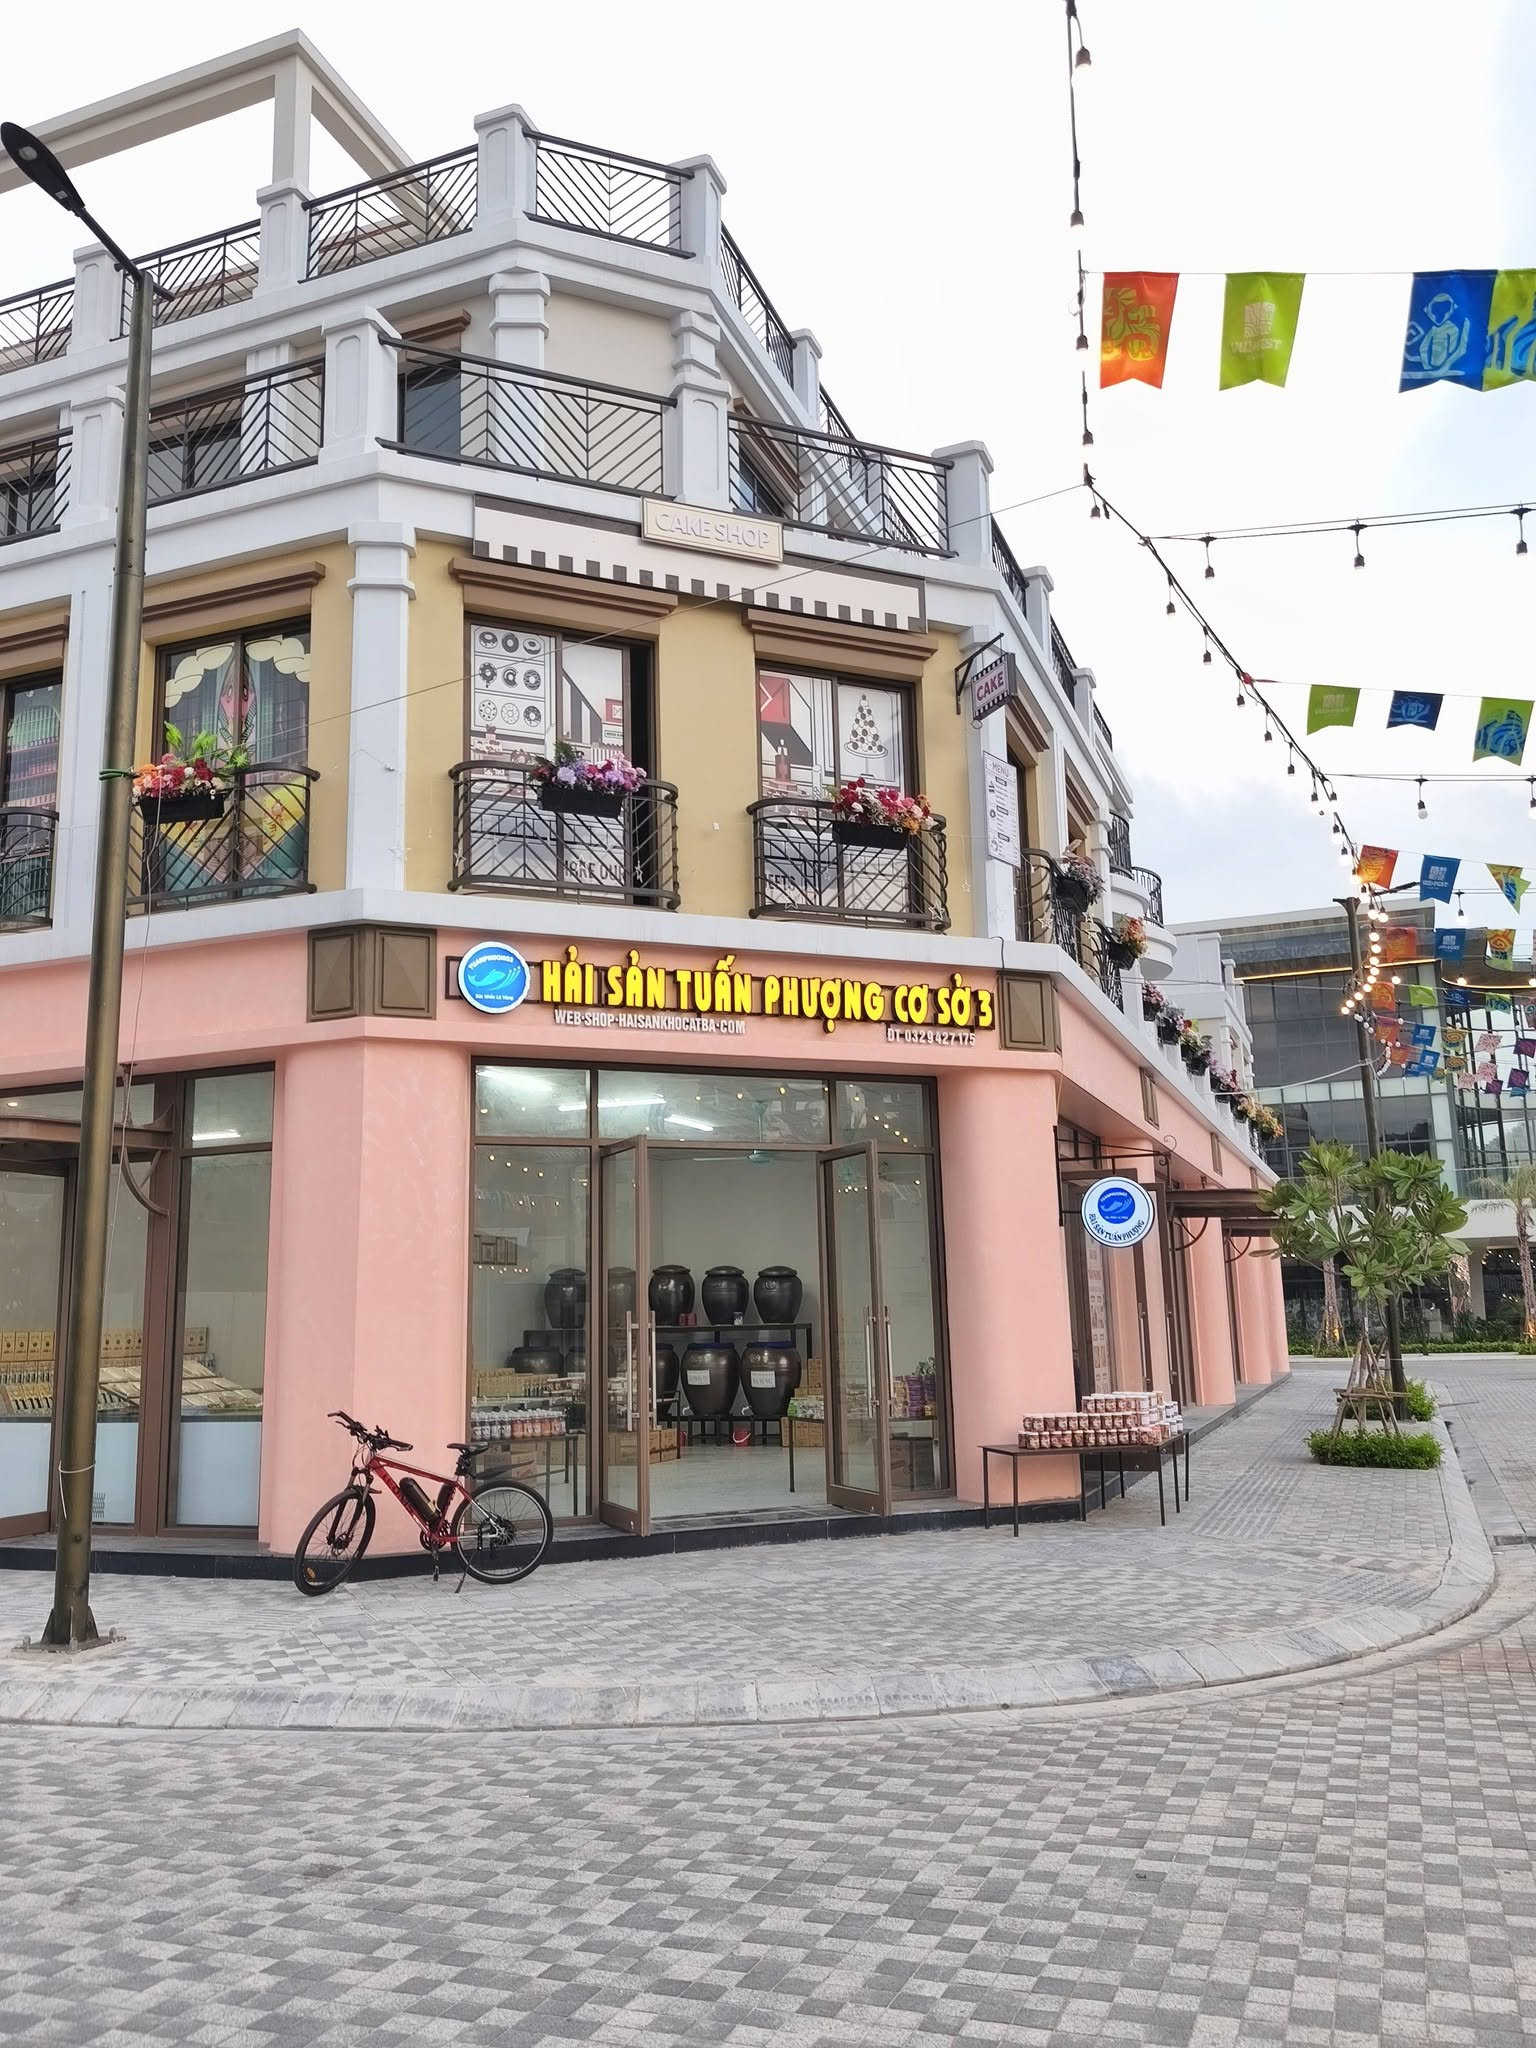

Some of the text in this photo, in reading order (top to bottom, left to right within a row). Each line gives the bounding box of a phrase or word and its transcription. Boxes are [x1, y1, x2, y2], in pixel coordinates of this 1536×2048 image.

[655, 513, 771, 549] CAKE SHOP
[976, 670, 1005, 702] CAKE
[541, 945, 993, 1033] HẢI SẢN TUẤN PHƯỢNG CƠ SỞ 3
[904, 1030, 976, 1046] 0329427175
